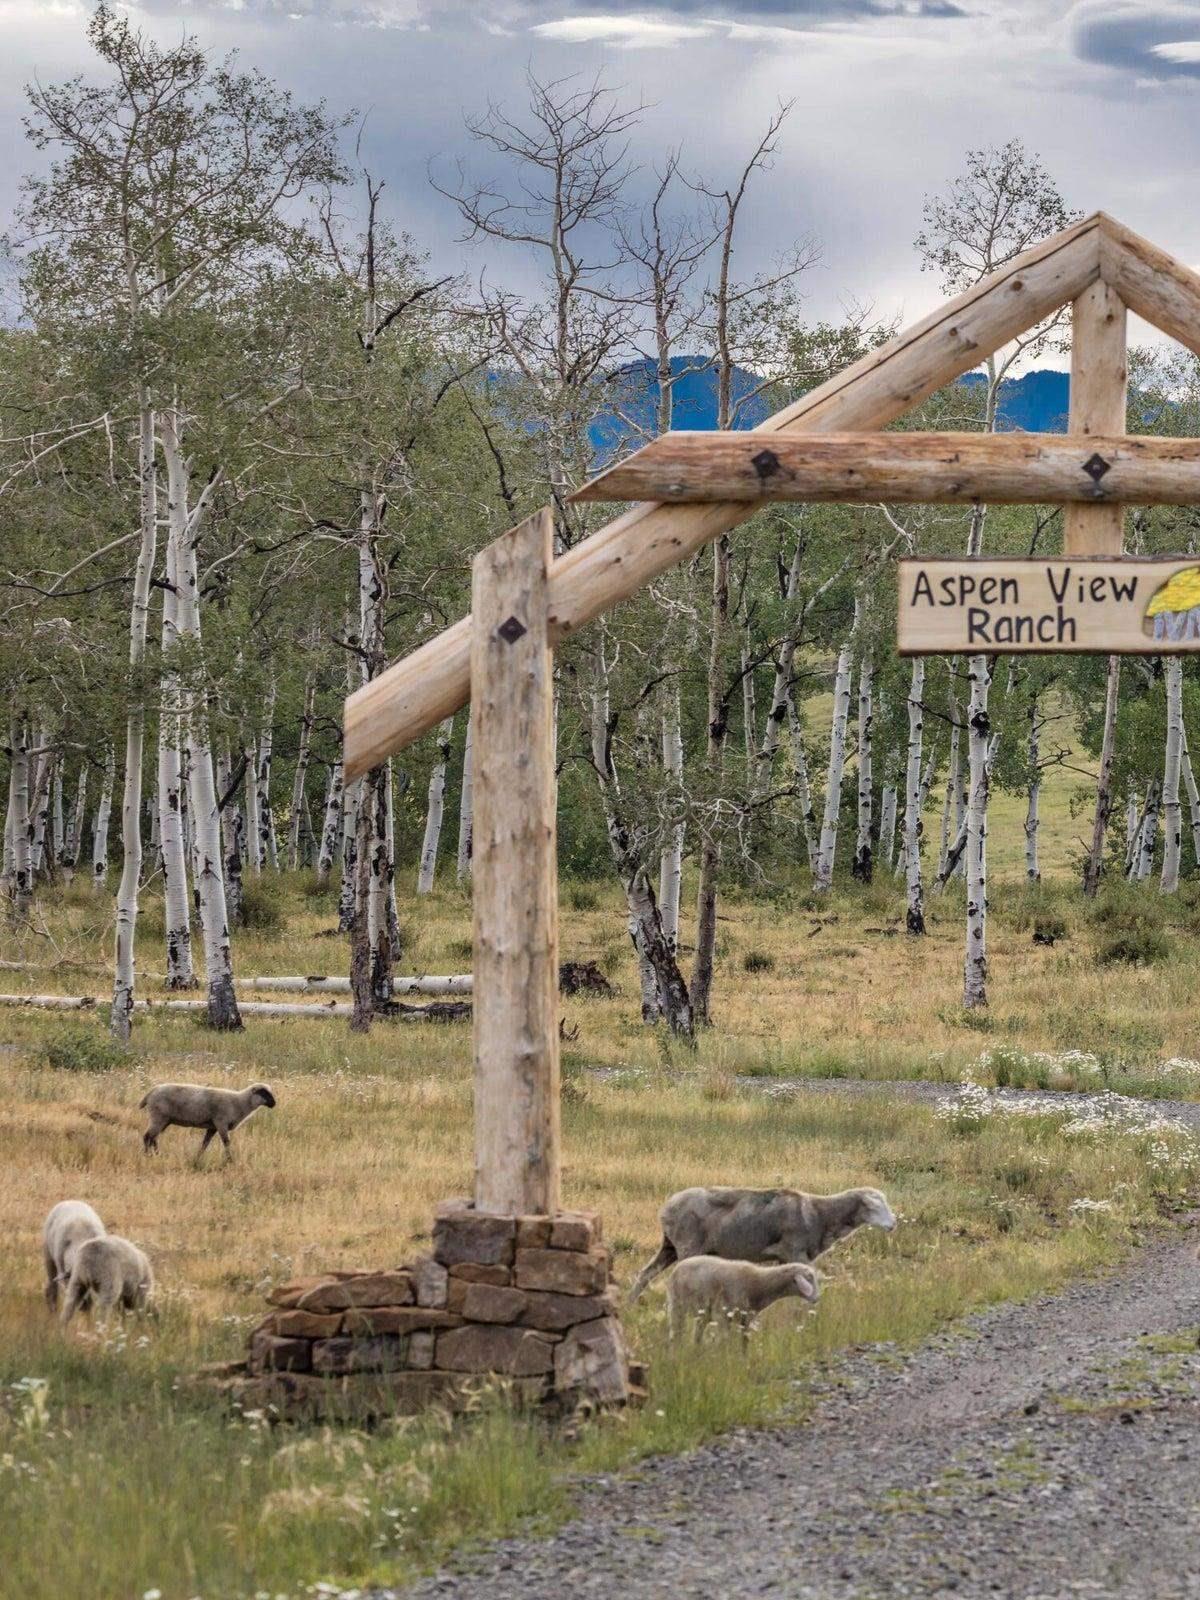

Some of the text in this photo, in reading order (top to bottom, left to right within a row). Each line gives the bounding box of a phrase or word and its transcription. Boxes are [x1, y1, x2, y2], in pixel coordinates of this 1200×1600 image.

[911, 567, 1138, 606] Aspen View
[967, 605, 1077, 643] Ranch
